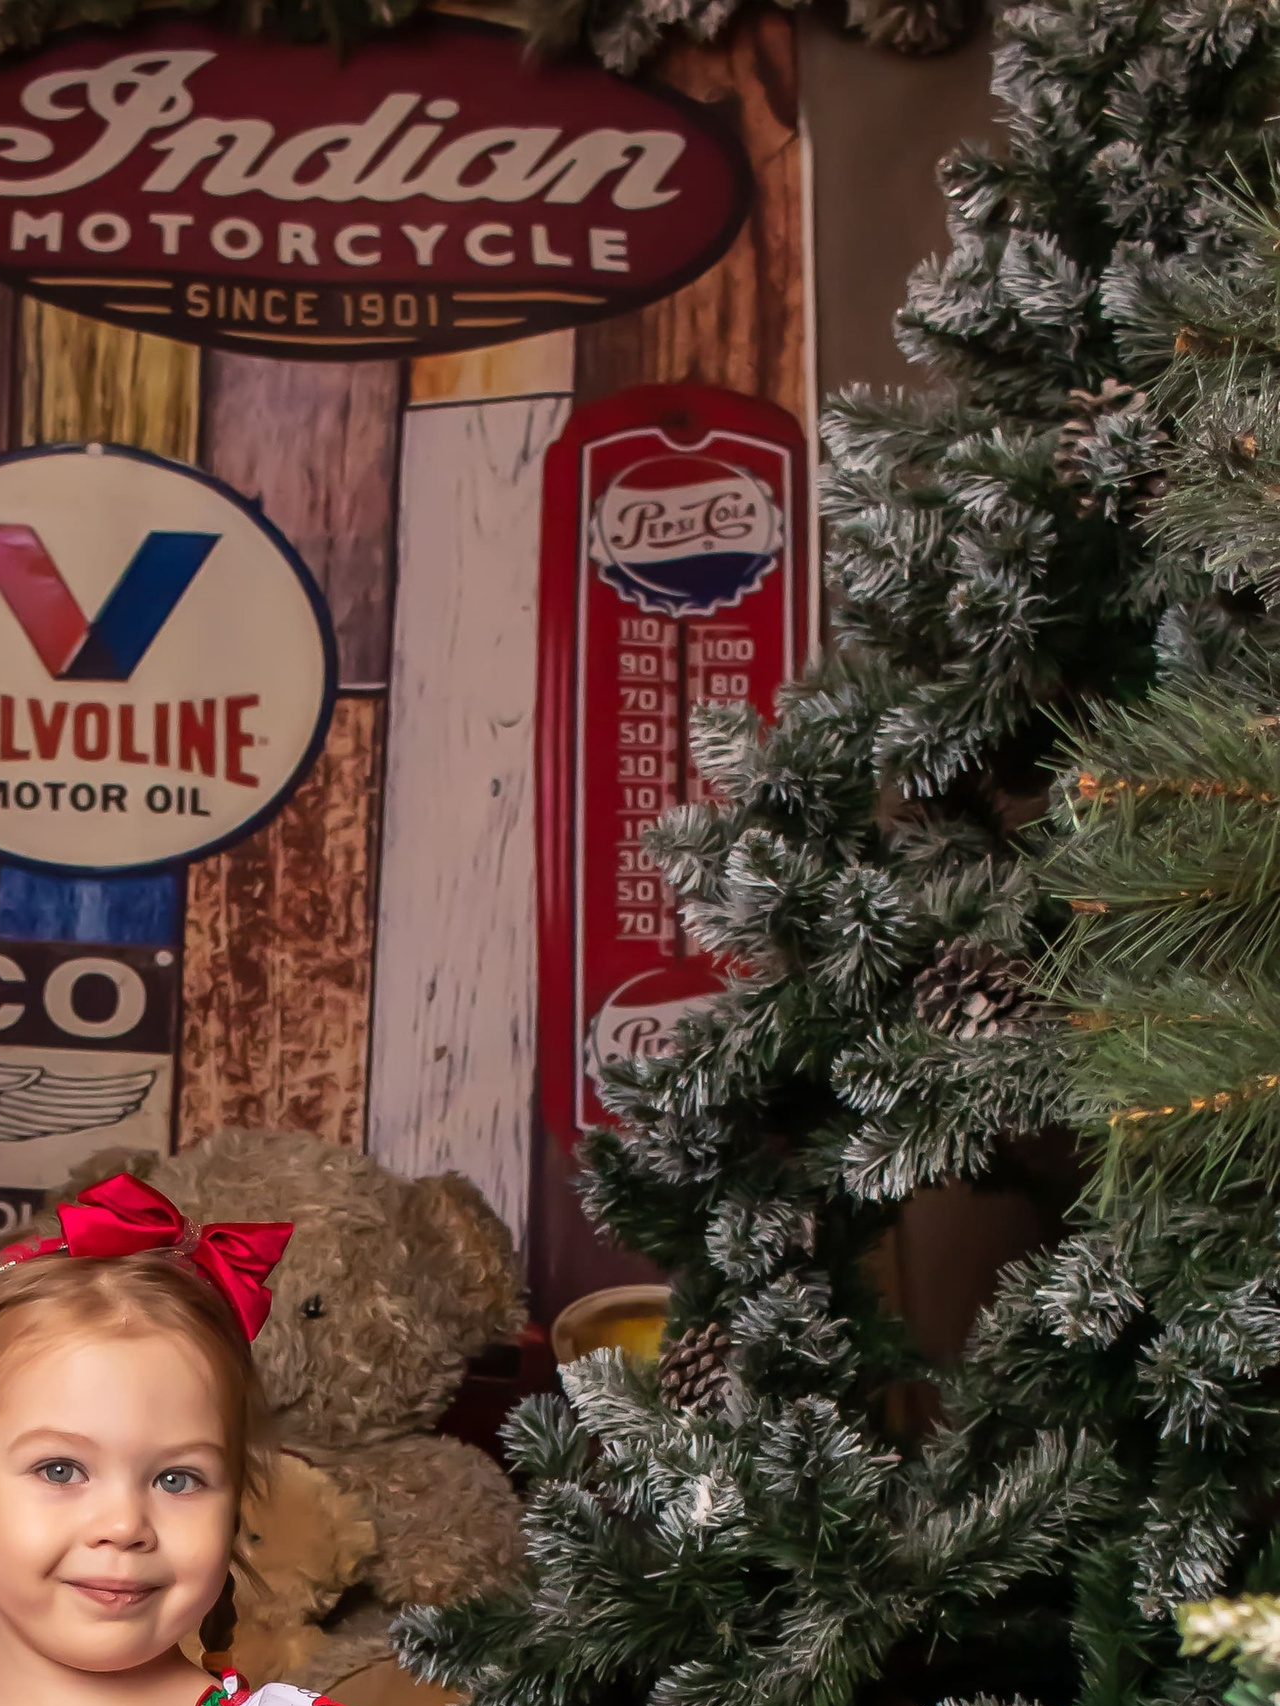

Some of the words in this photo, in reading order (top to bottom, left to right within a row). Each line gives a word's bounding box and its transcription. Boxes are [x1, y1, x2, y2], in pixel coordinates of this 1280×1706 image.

[10, 212, 631, 273] MOTORCYCLE
[186, 285, 319, 327] SINCE
[343, 294, 441, 329] 1901
[621, 618, 659, 641] 110
[704, 639, 754, 660] 100
[620, 653, 657, 675] 90
[711, 674, 748, 695] 80
[620, 689, 657, 710] 70
[621, 723, 656, 743] 50
[620, 756, 656, 776] 30
[145, 785, 212, 817] OIL
[618, 881, 654, 900] 50
[620, 913, 654, 933] 70
